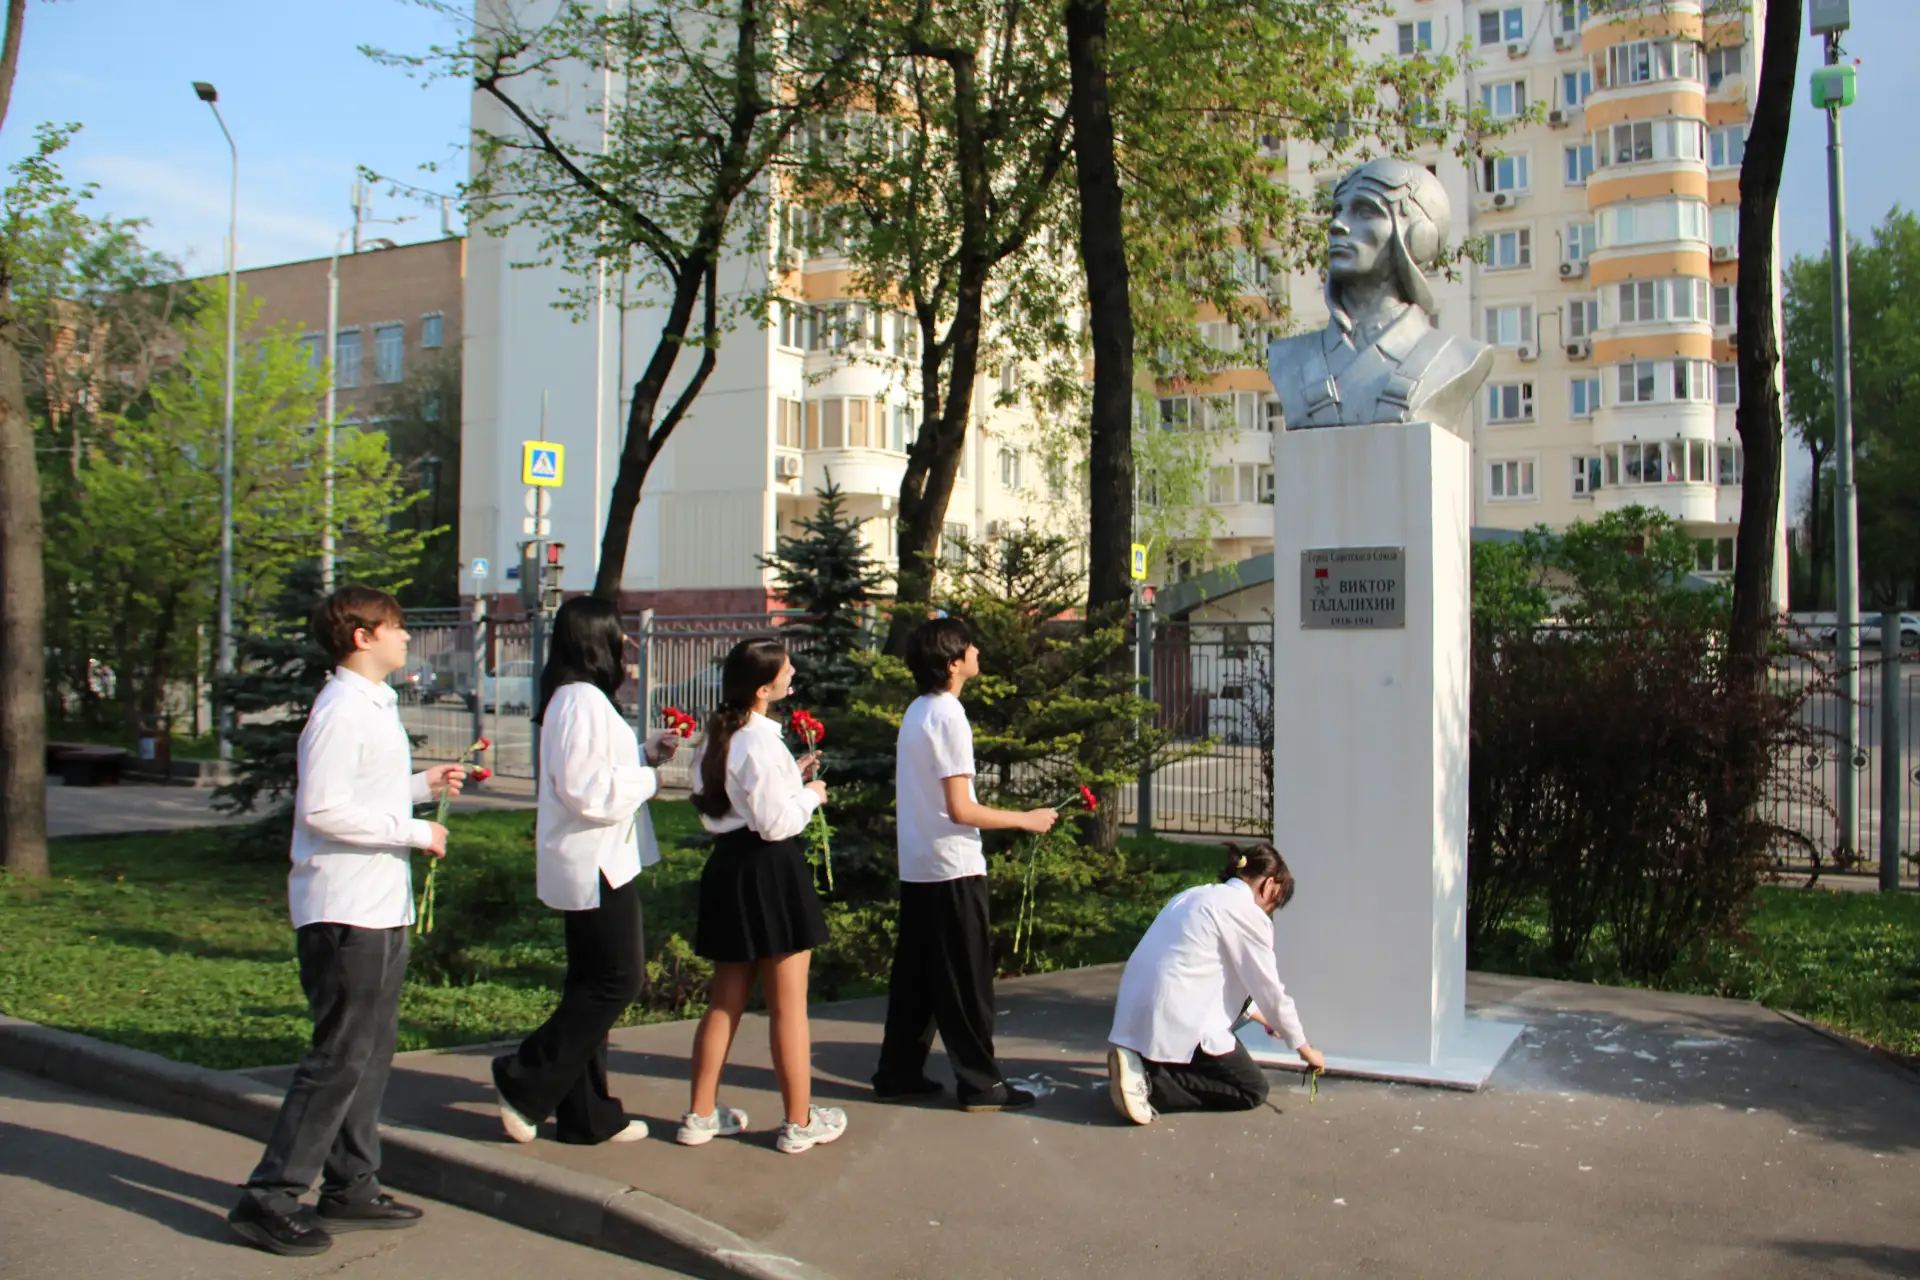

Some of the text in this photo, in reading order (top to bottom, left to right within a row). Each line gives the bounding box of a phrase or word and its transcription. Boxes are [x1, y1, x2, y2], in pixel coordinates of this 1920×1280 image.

[1339, 579, 1395, 594] ВИКТОР
[1310, 597, 1395, 612] ТАЛАЛИХИН
[1331, 616, 1374, 626] 1918-1941
